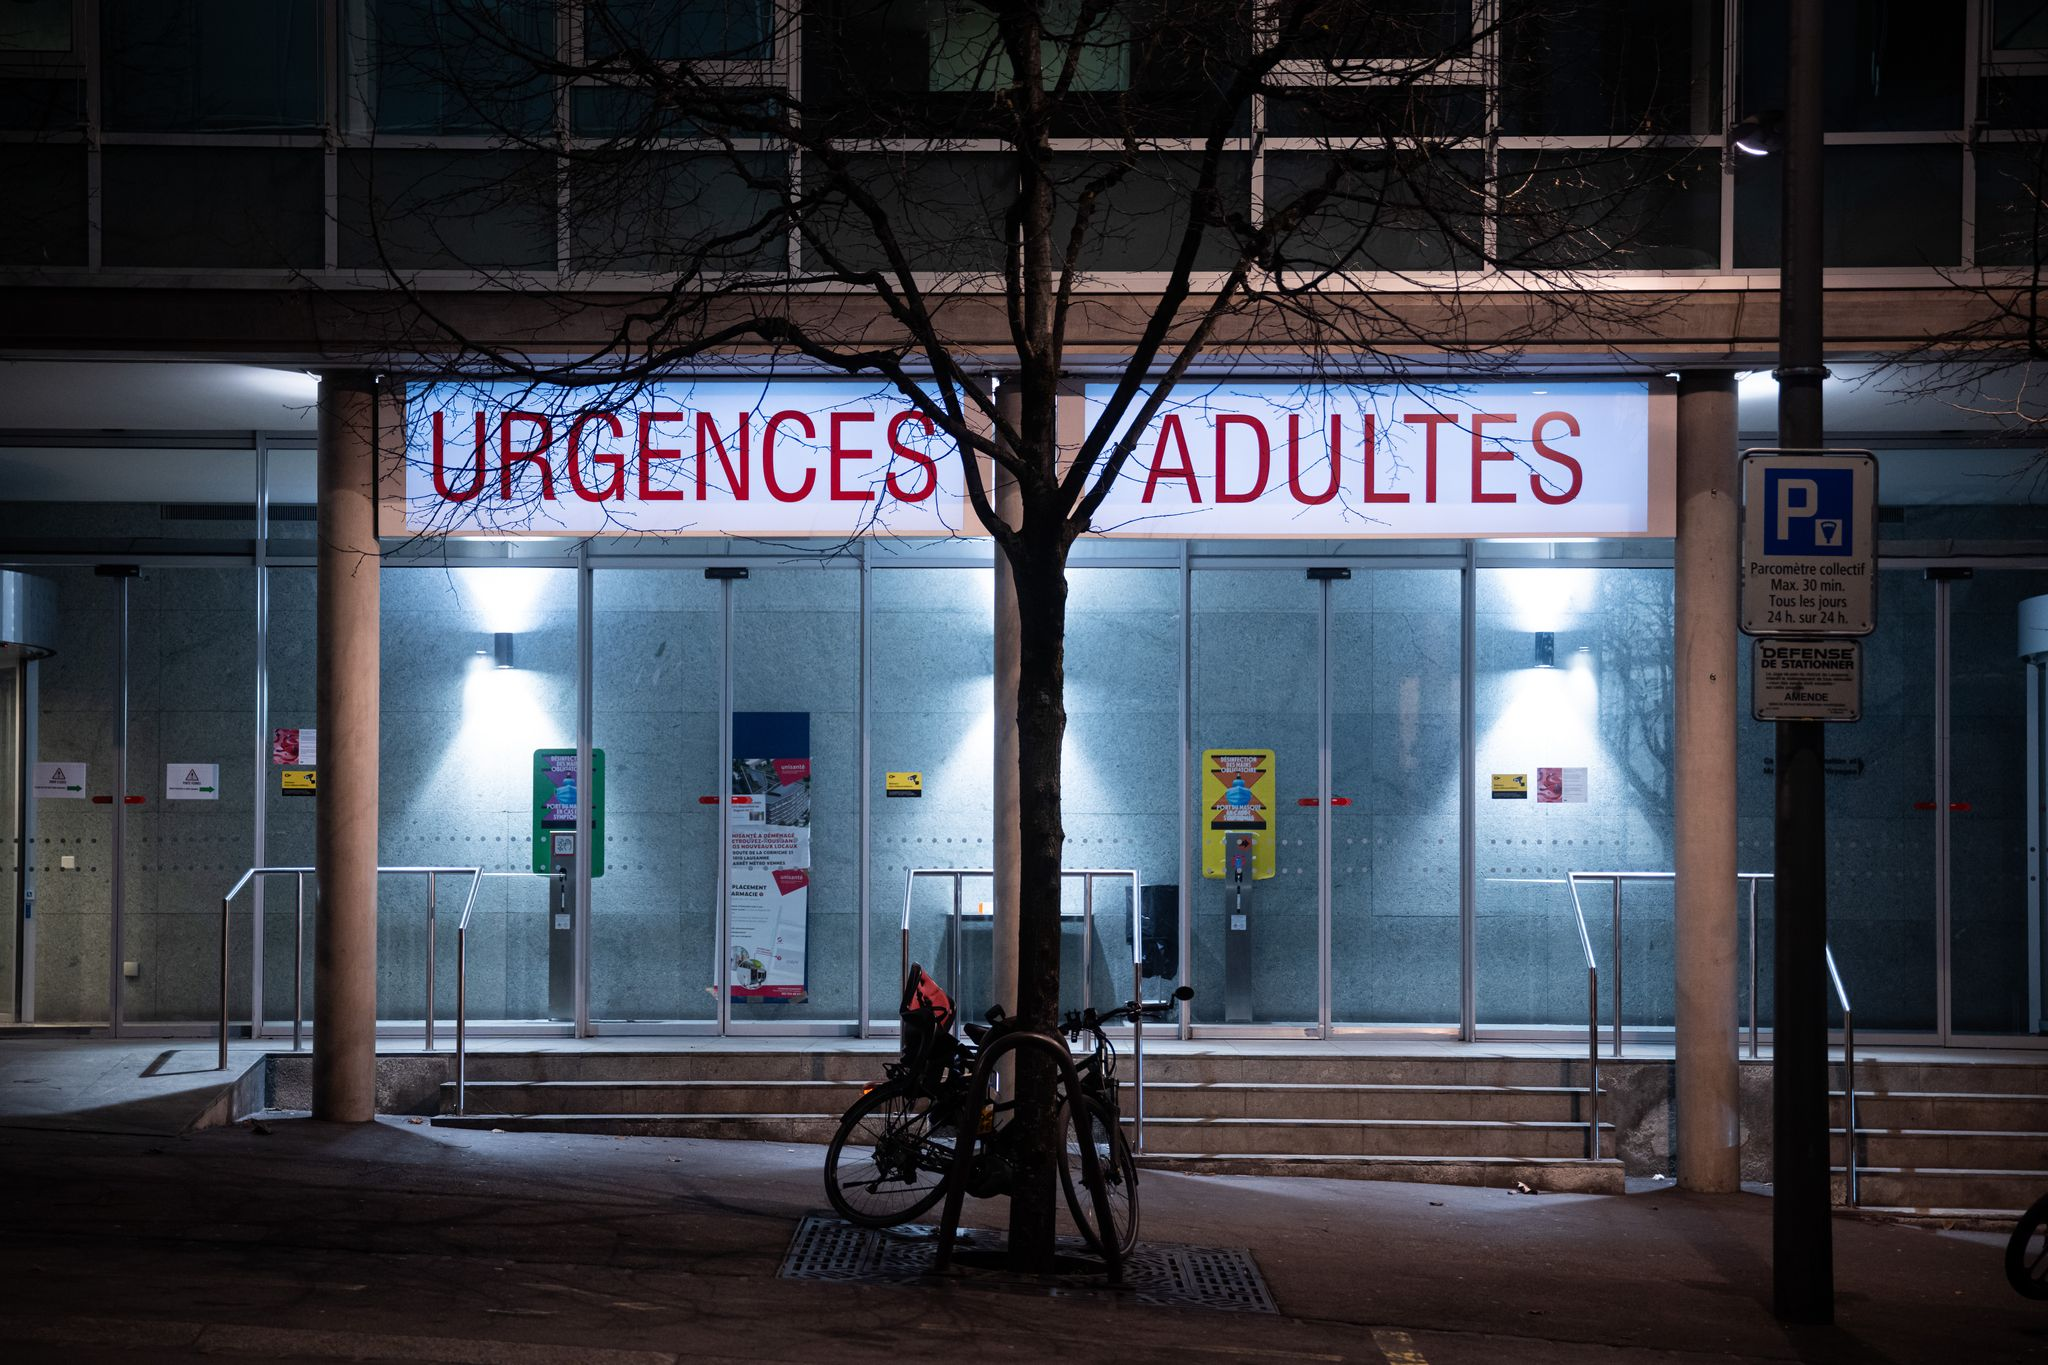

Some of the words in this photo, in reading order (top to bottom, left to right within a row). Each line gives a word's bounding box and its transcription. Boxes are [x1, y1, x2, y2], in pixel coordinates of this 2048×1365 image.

[431, 409, 938, 504] URGENCES
[1140, 410, 1584, 506] ADULTES
[1777, 478, 1818, 540] P
[1750, 562, 1816, 575] Parcomètre
[1820, 562, 1865, 576] collectif
[1771, 579, 1799, 591] Max.
[1803, 579, 1817, 591] 30
[1820, 579, 1845, 592] min.
[1769, 594, 1796, 607] Tous
[1799, 594, 1815, 608] les
[1818, 595, 1847, 610] jours
[1767, 611, 1783, 623] 24
[1785, 611, 1796, 623] h.
[1799, 615, 1816, 624] sur
[1820, 611, 1835, 624] 24
[1838, 611, 1848, 624] h.
[1761, 660, 1776, 668] DE
[1781, 660, 1854, 669] STATIONNER
[1784, 693, 1829, 701] AMENDE
